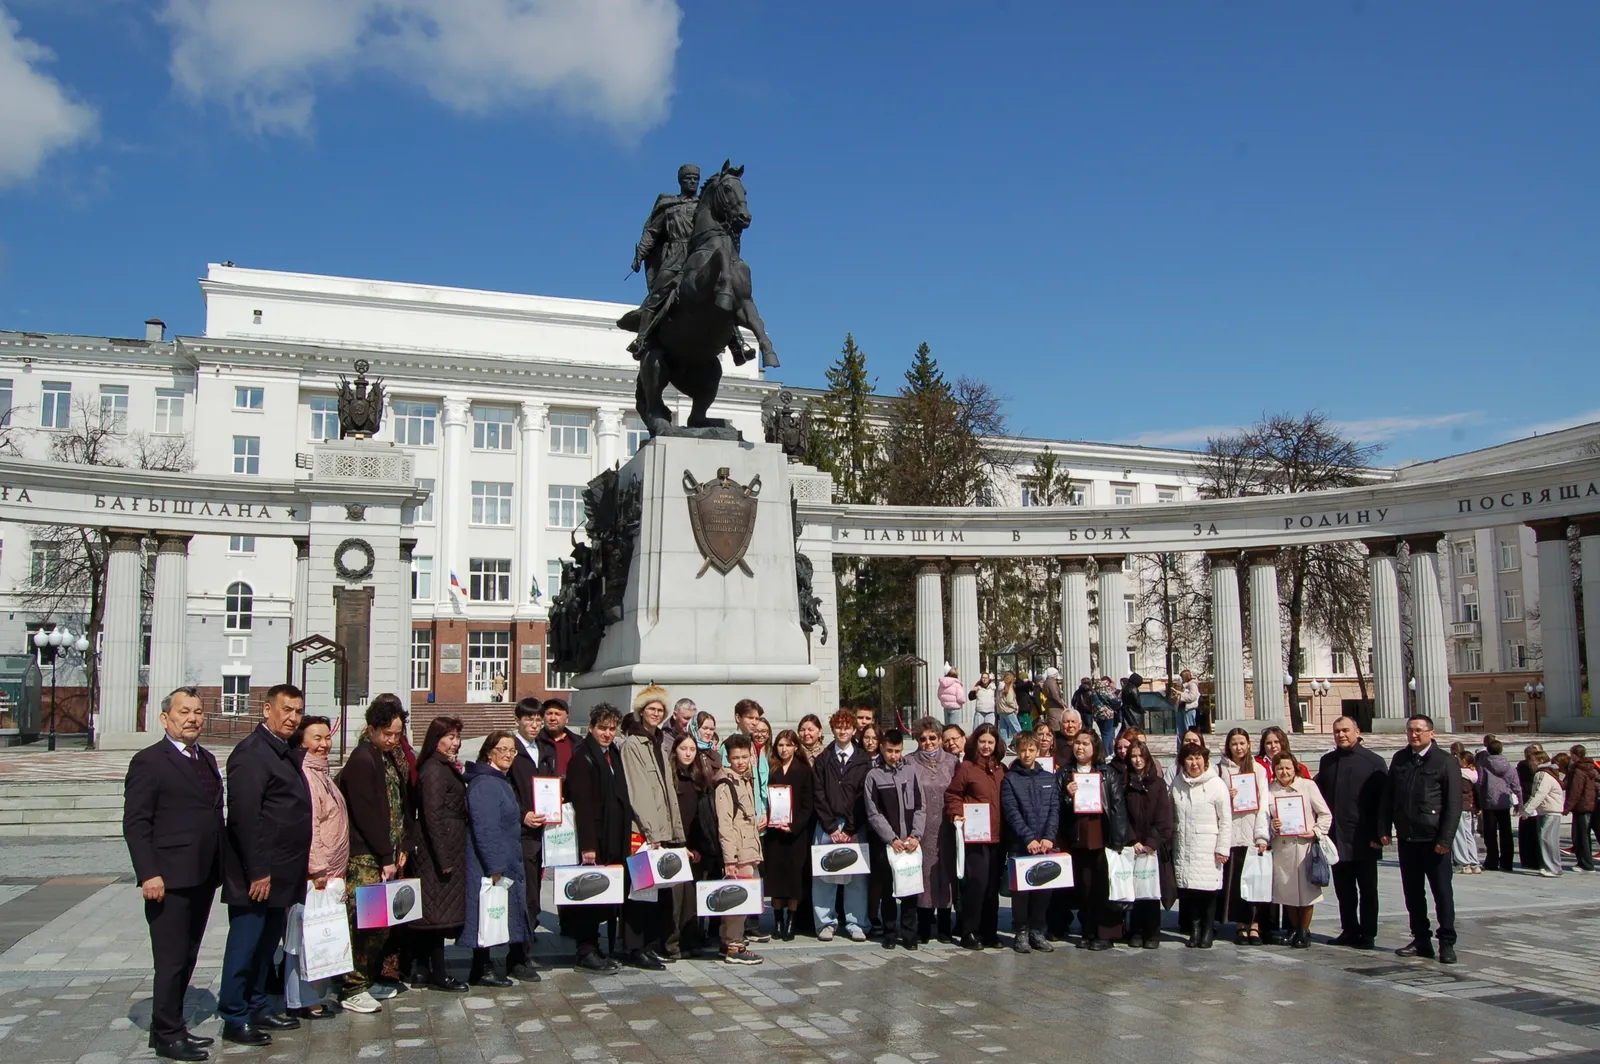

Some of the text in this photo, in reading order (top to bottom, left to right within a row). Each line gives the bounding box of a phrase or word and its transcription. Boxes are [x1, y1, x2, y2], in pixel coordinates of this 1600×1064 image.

[94, 493, 272, 519] БАҒЫШЛАНА
[863, 481, 1600, 542] ПАВШИМ В БОЯХ ЗА РОДИНУ ПОСВЯЩА
